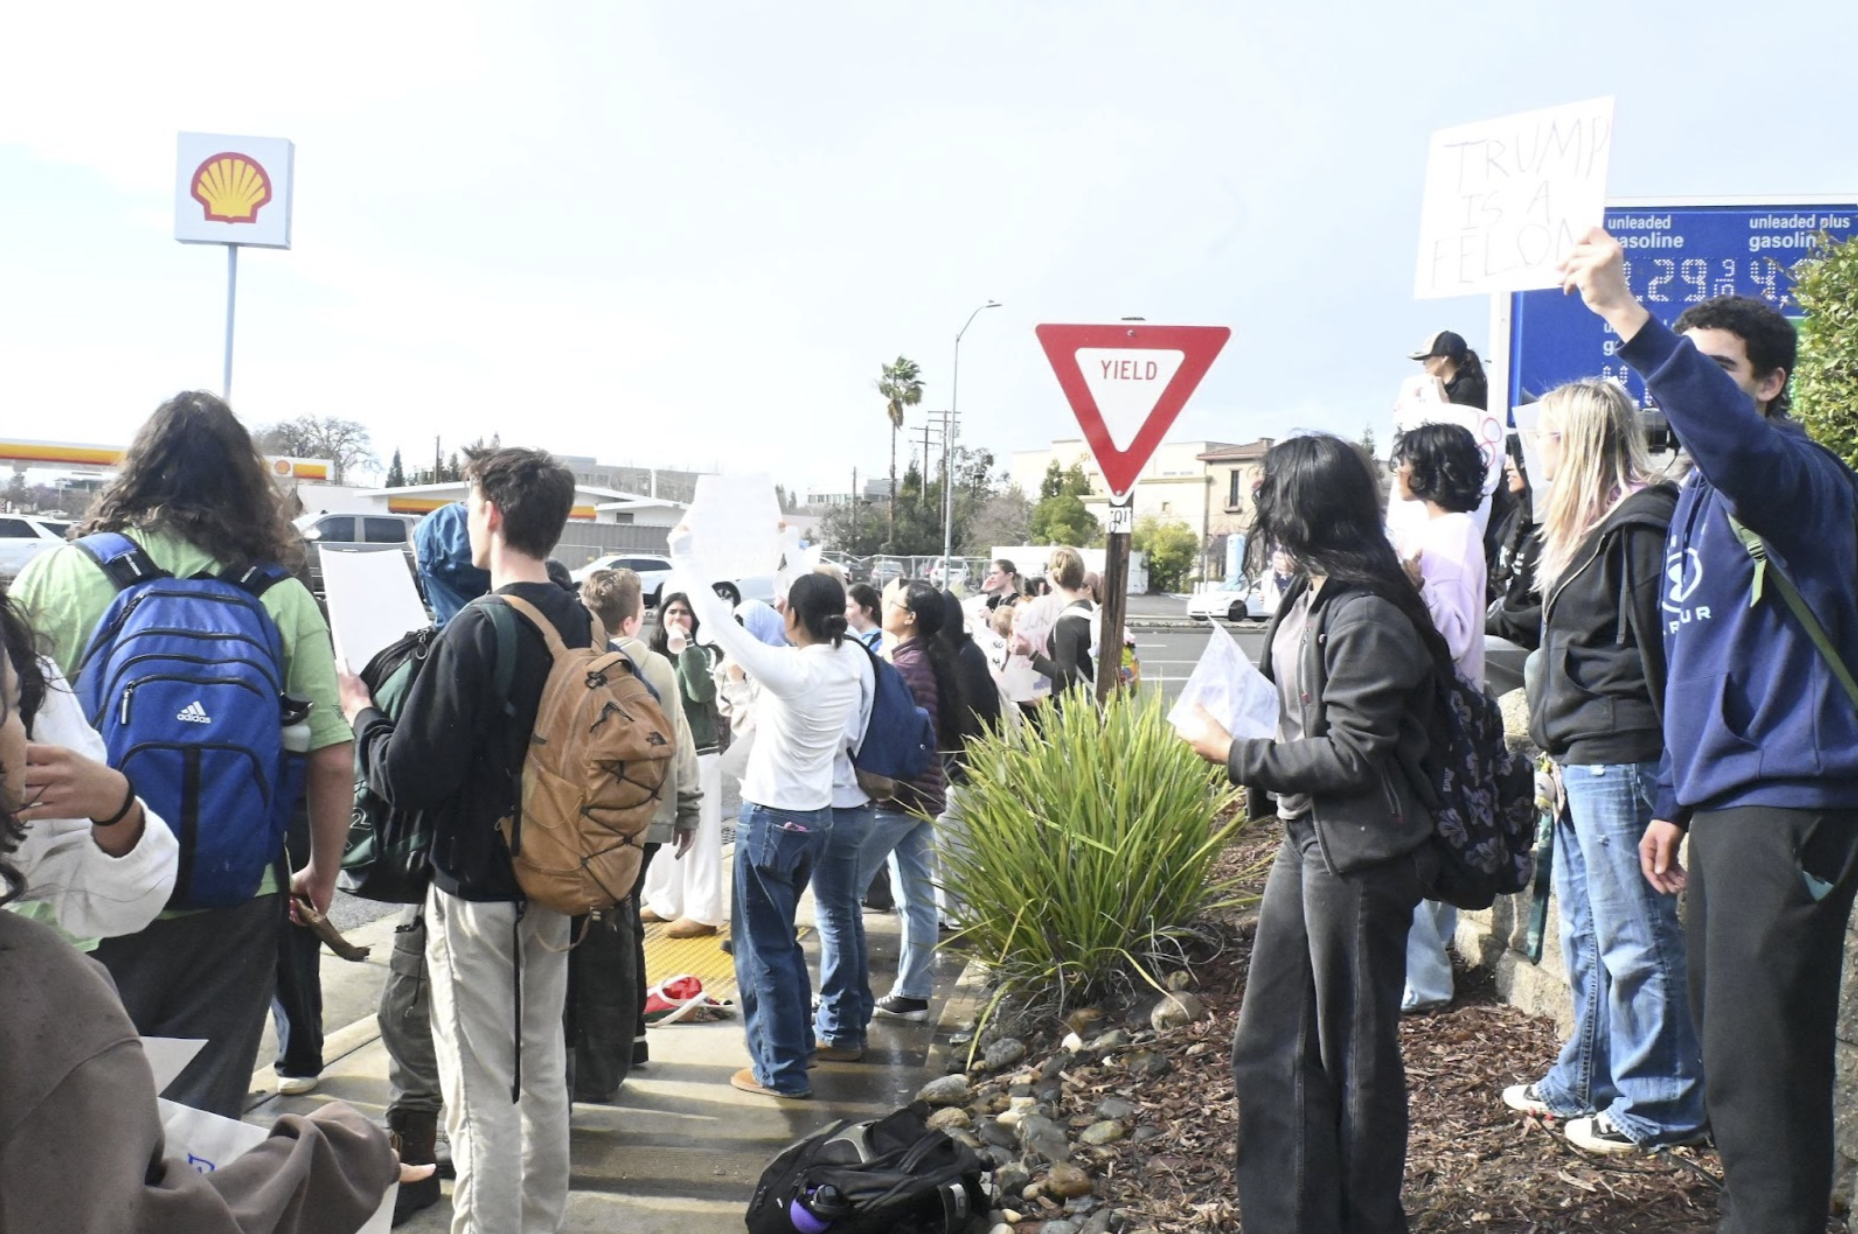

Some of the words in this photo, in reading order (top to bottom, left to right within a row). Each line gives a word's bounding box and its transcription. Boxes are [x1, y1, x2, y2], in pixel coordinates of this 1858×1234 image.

[1443, 116, 1610, 193] TRUMP
[1461, 191, 1503, 231] IS
[1526, 180, 1551, 224] A
[1608, 215, 1672, 230] unleaded
[1749, 213, 1816, 229] unleaded
[1819, 213, 1851, 230] plus
[1615, 231, 1685, 249] asoline
[1748, 231, 1818, 253] gasolin
[1101, 360, 1158, 381] YIELD
[177, 712, 211, 724] adidas
